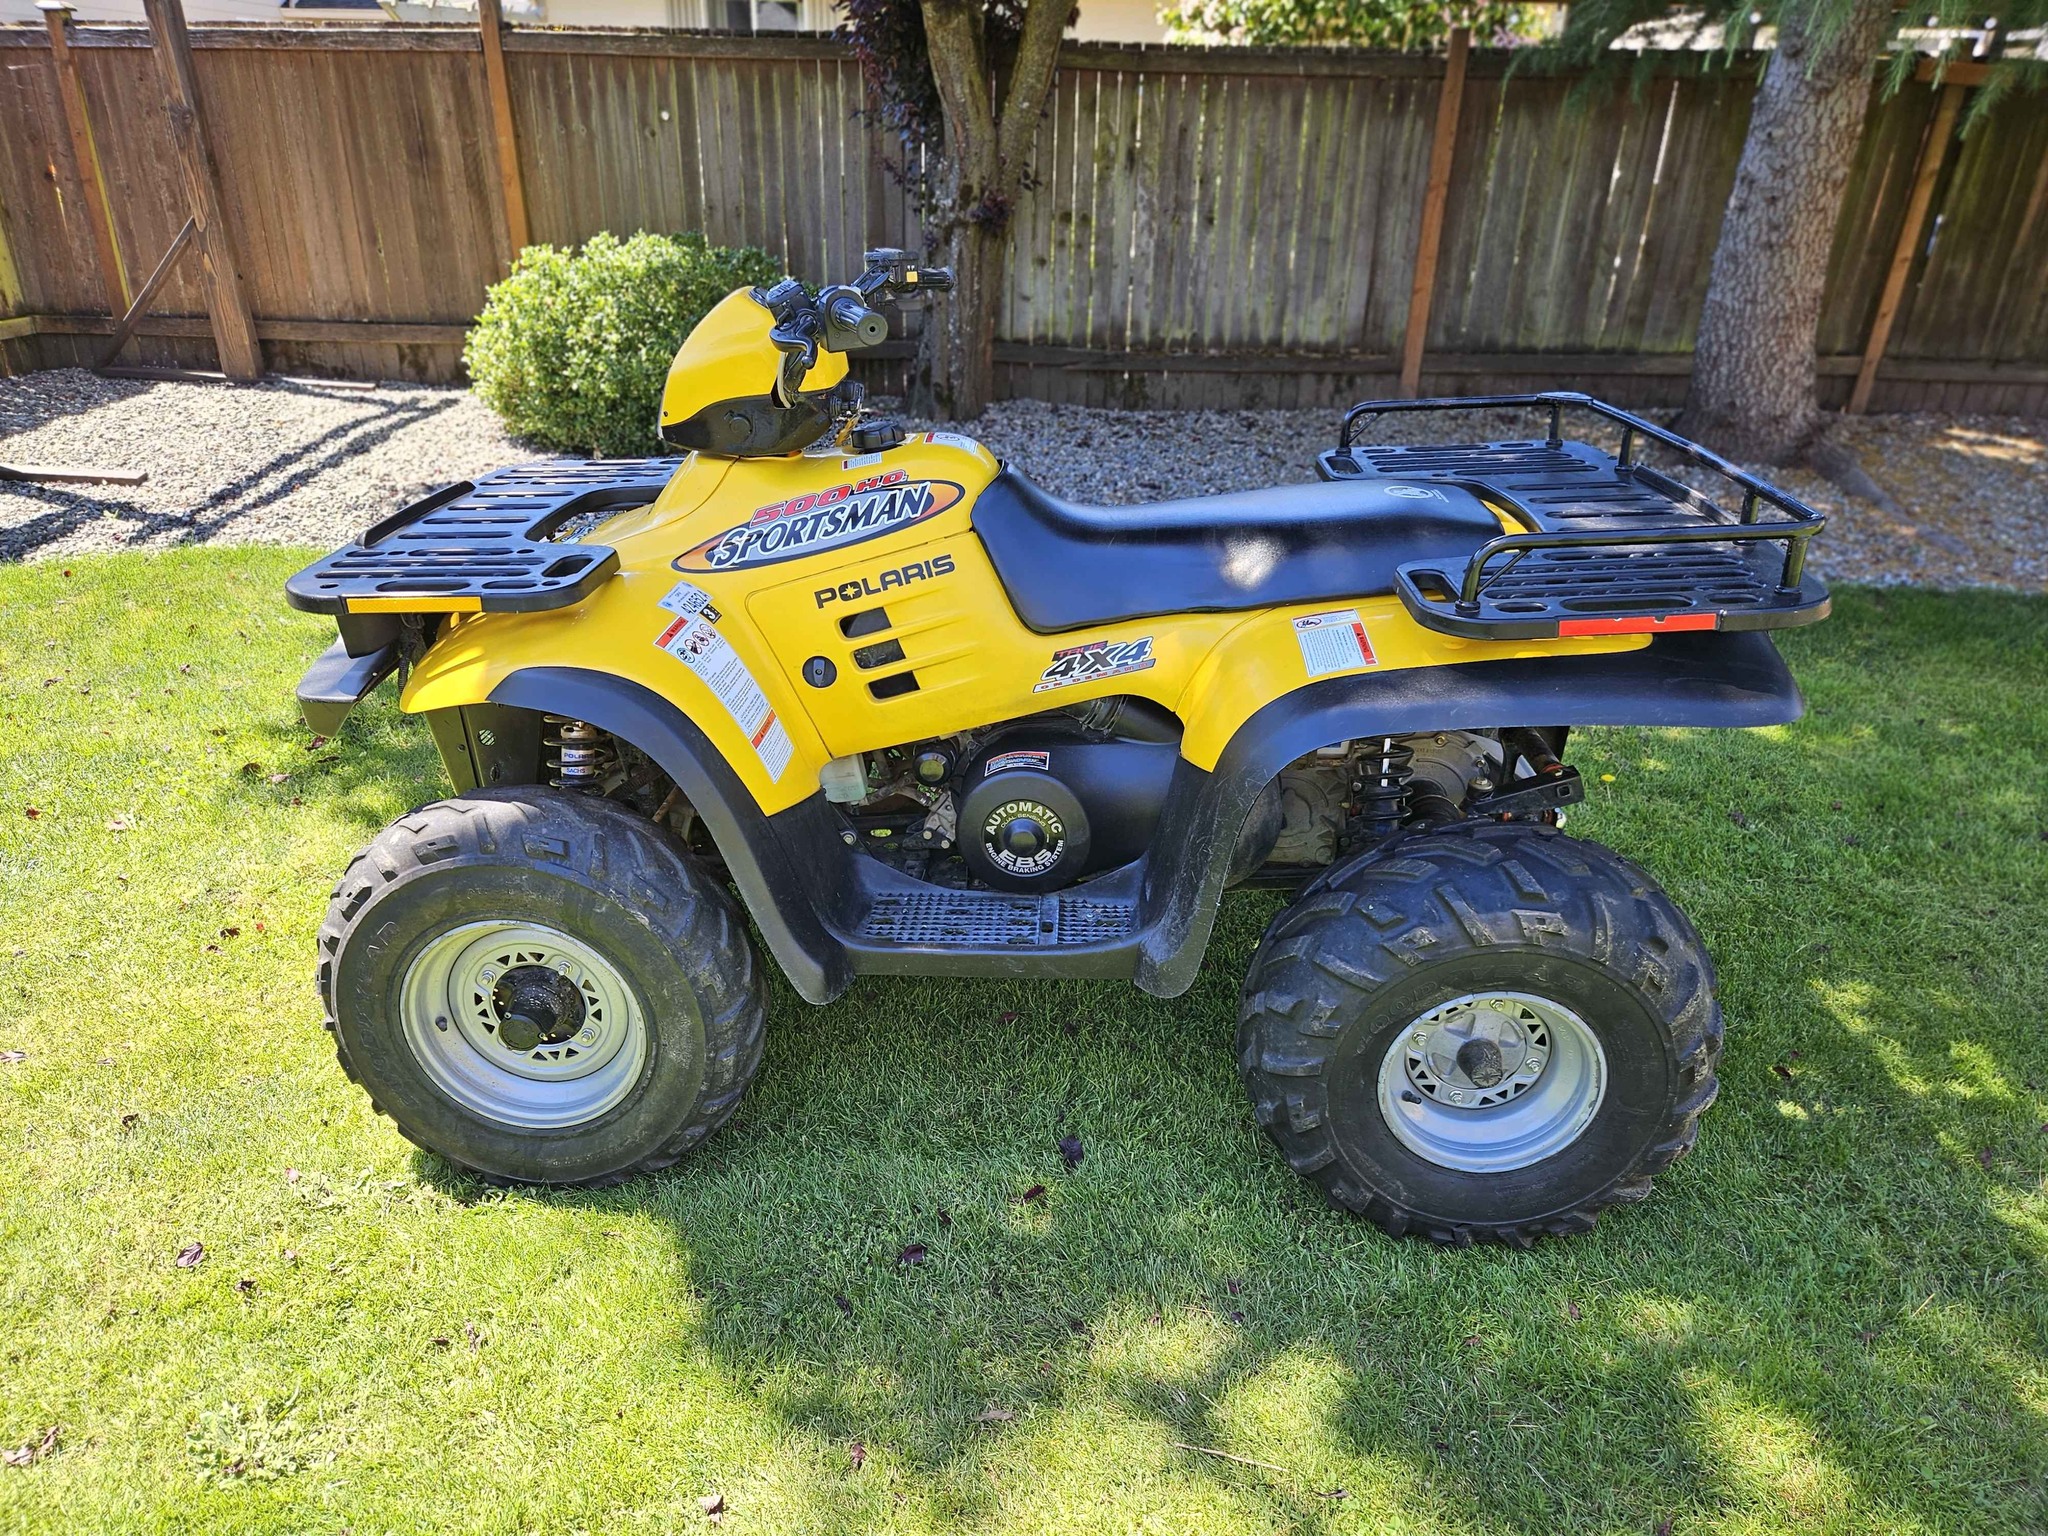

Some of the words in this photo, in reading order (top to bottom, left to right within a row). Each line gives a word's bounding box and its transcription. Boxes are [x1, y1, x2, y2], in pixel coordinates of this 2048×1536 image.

[711, 482, 931, 568] SPORTSMAN
[750, 485, 852, 527] 500
[814, 554, 956, 610] POLARIS
[703, 608, 714, 619] 3
[1041, 636, 1154, 681] 4X4
[985, 801, 1063, 836] AUTOMATIC
[985, 842, 1006, 868] ENGINE
[1007, 863, 1045, 874] BRAKING
[1045, 839, 1065, 867] SYSTEM
[998, 848, 1052, 868] EBS
